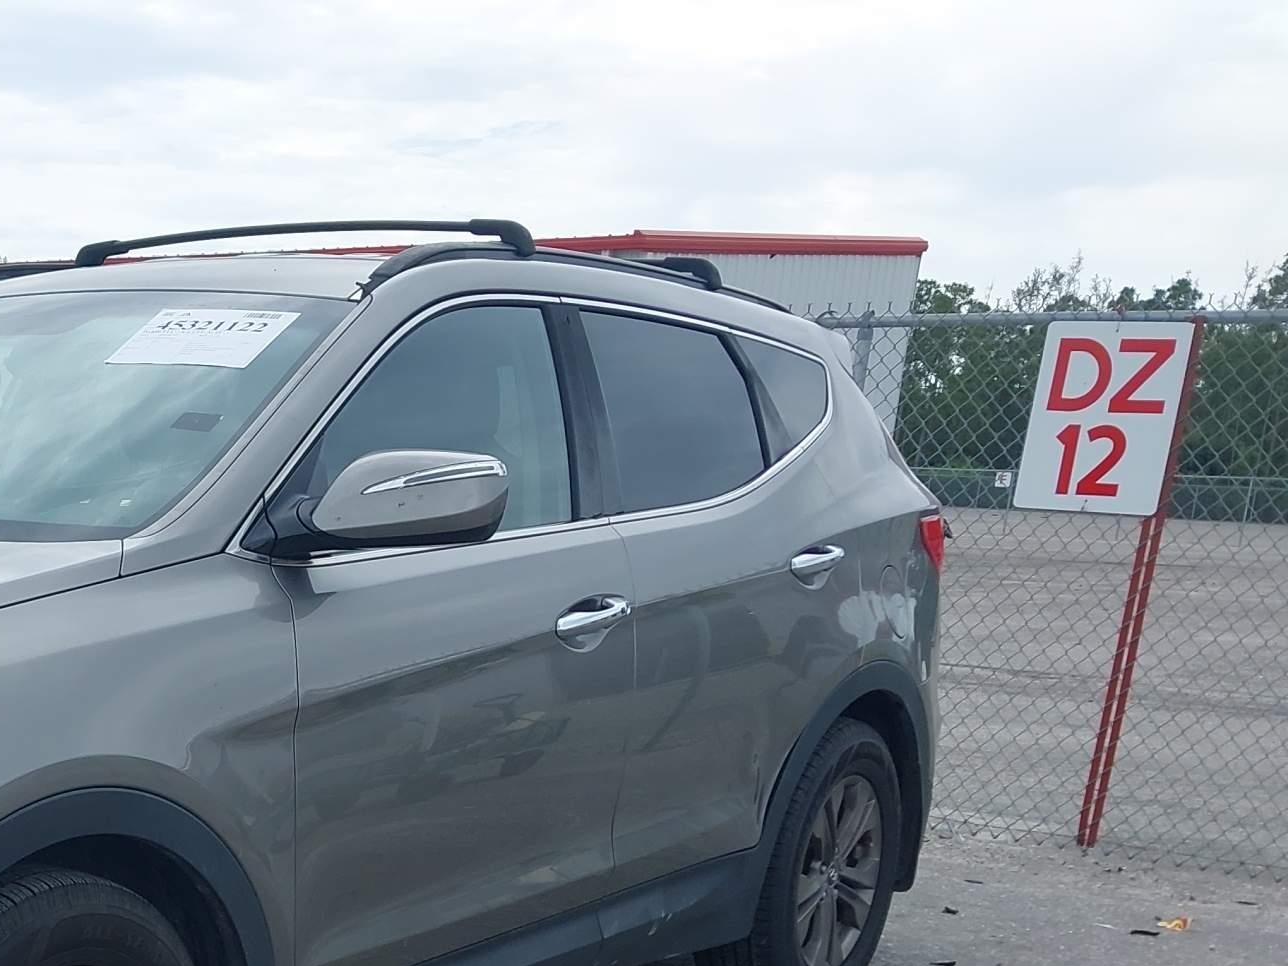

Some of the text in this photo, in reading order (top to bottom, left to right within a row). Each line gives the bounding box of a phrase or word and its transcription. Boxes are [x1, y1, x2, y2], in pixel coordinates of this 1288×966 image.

[156, 320, 268, 333] 45321122
[1046, 338, 1177, 413] DZ
[1055, 424, 1127, 497] 12
